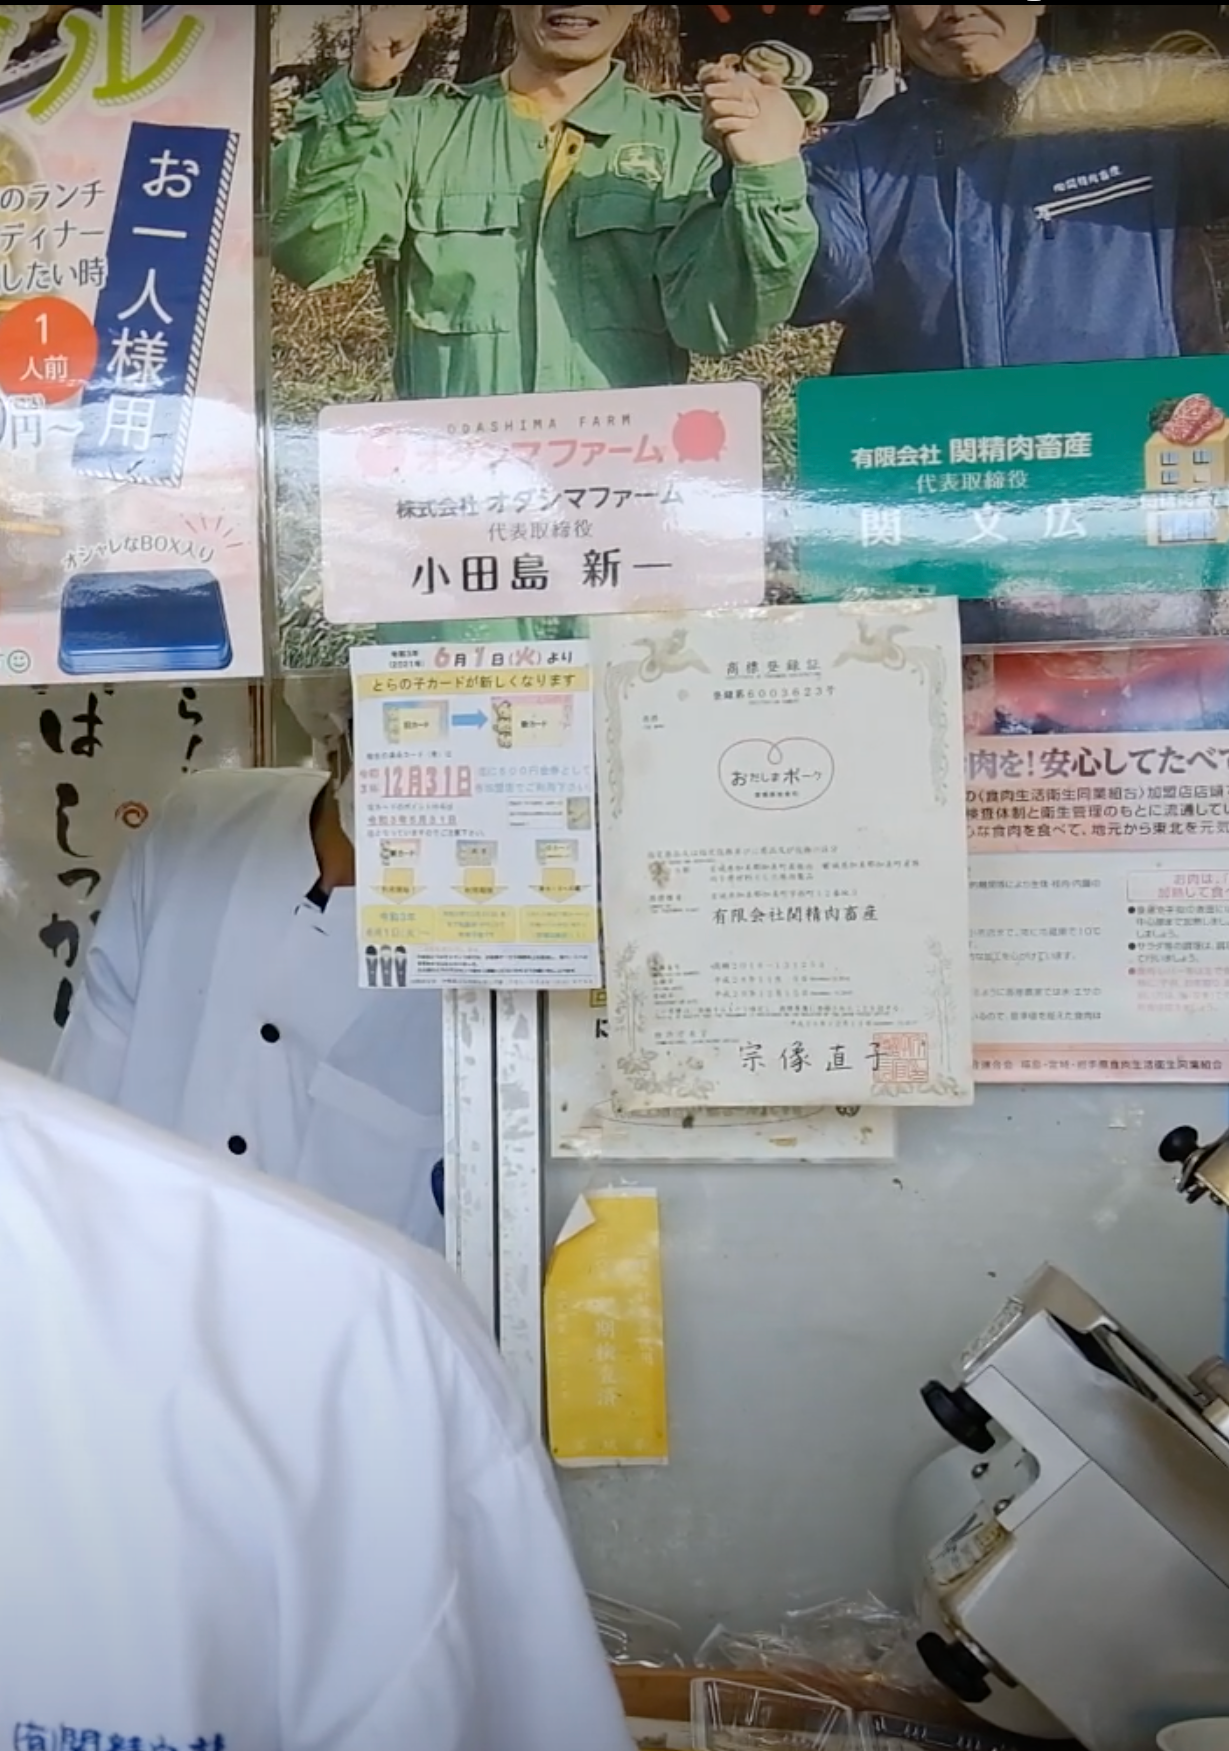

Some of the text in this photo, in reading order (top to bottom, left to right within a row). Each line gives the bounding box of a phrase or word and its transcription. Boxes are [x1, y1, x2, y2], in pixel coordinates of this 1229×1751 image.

[98, 149, 200, 451] お一人様用
[35, 313, 48, 344] 1
[20, 356, 69, 381] 人前
[447, 414, 632, 433] ODASHIMA FARM
[851, 432, 1092, 469] 有限会社 関精肉畜産
[916, 469, 1029, 493] 代表取締役
[396, 486, 683, 519] 株式会社 オダシマファーム
[488, 520, 594, 541] 代表取締役
[63, 535, 214, 569] オシャレなBOX入り
[412, 548, 673, 594] 小田島 新一
[372, 673, 576, 692] とらの子カードが新しくなります
[385, 764, 471, 796] 12月31日
[713, 904, 879, 924] 有限会社関精肉畜産
